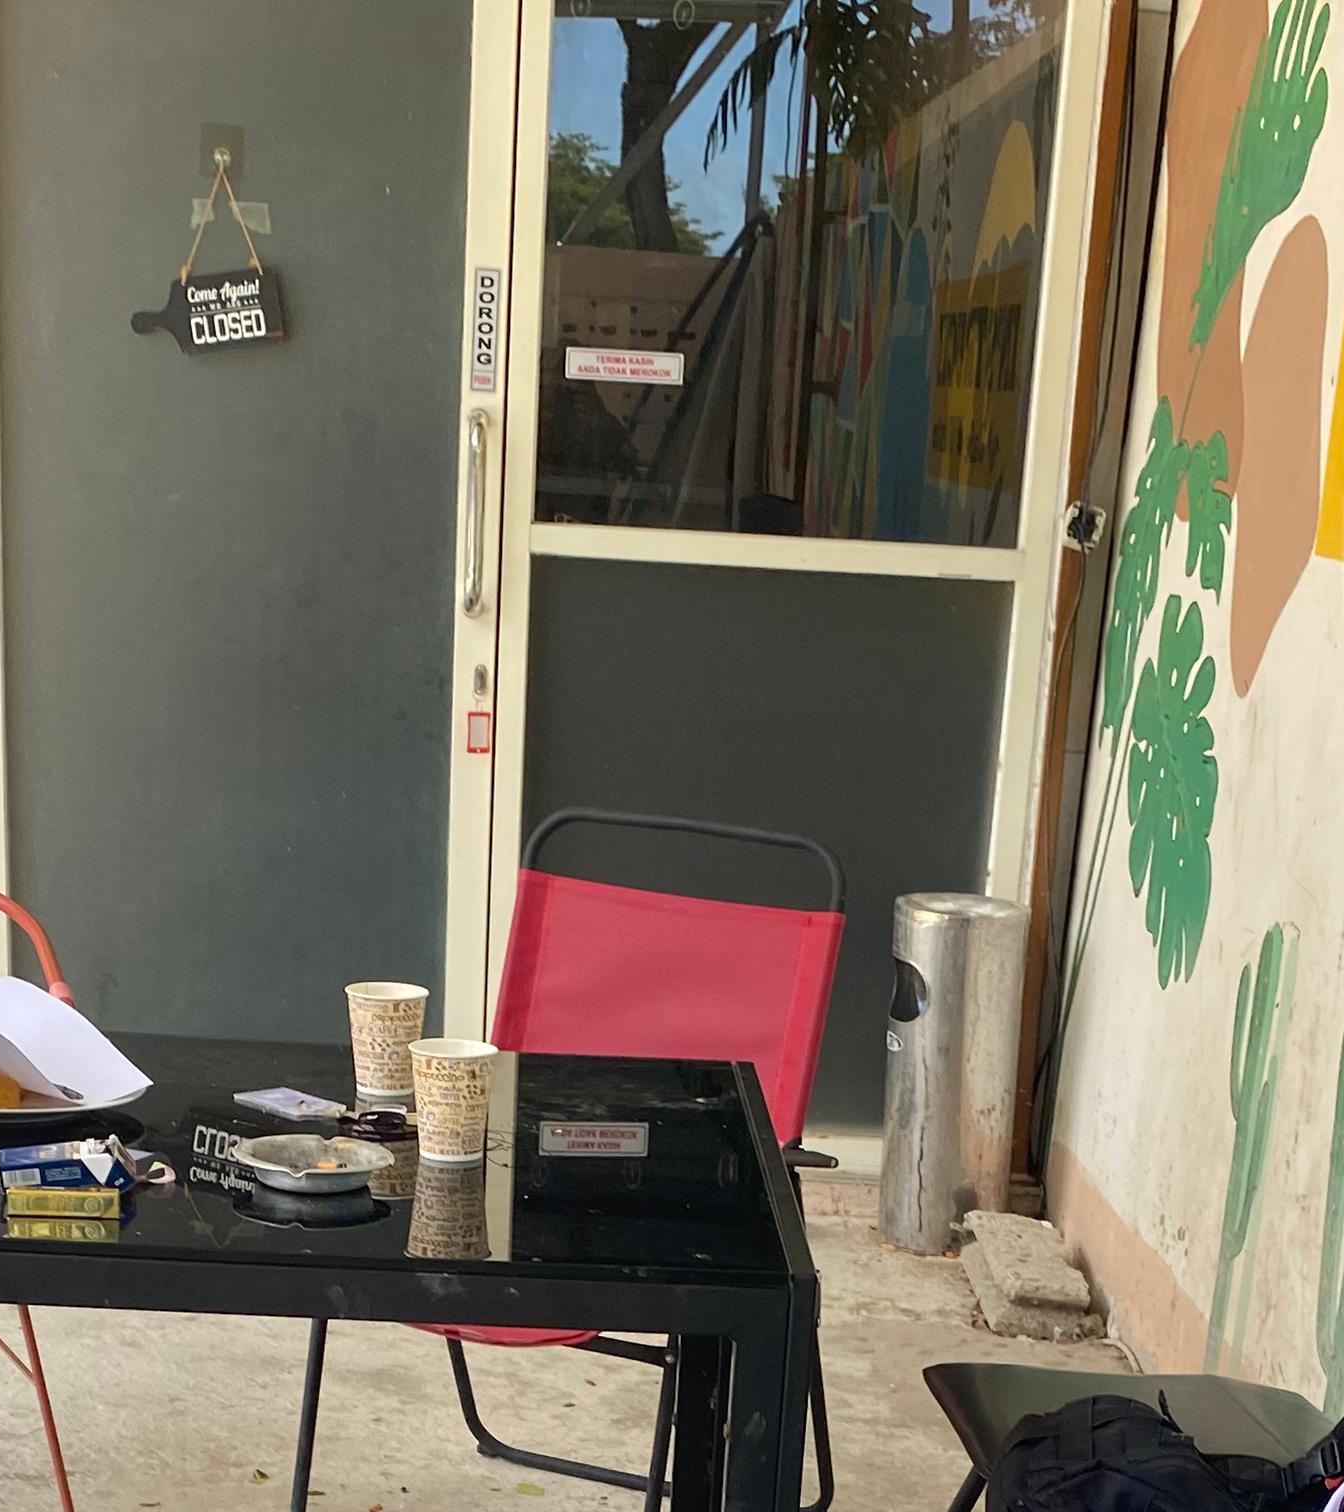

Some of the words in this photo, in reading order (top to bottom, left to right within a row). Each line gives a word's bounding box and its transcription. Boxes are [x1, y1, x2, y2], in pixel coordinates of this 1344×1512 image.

[187, 286, 218, 304] Come
[219, 278, 260, 303] Again!
[190, 308, 266, 345] CLOSED
[476, 275, 495, 366] DORONG
[577, 364, 601, 375] ANDA
